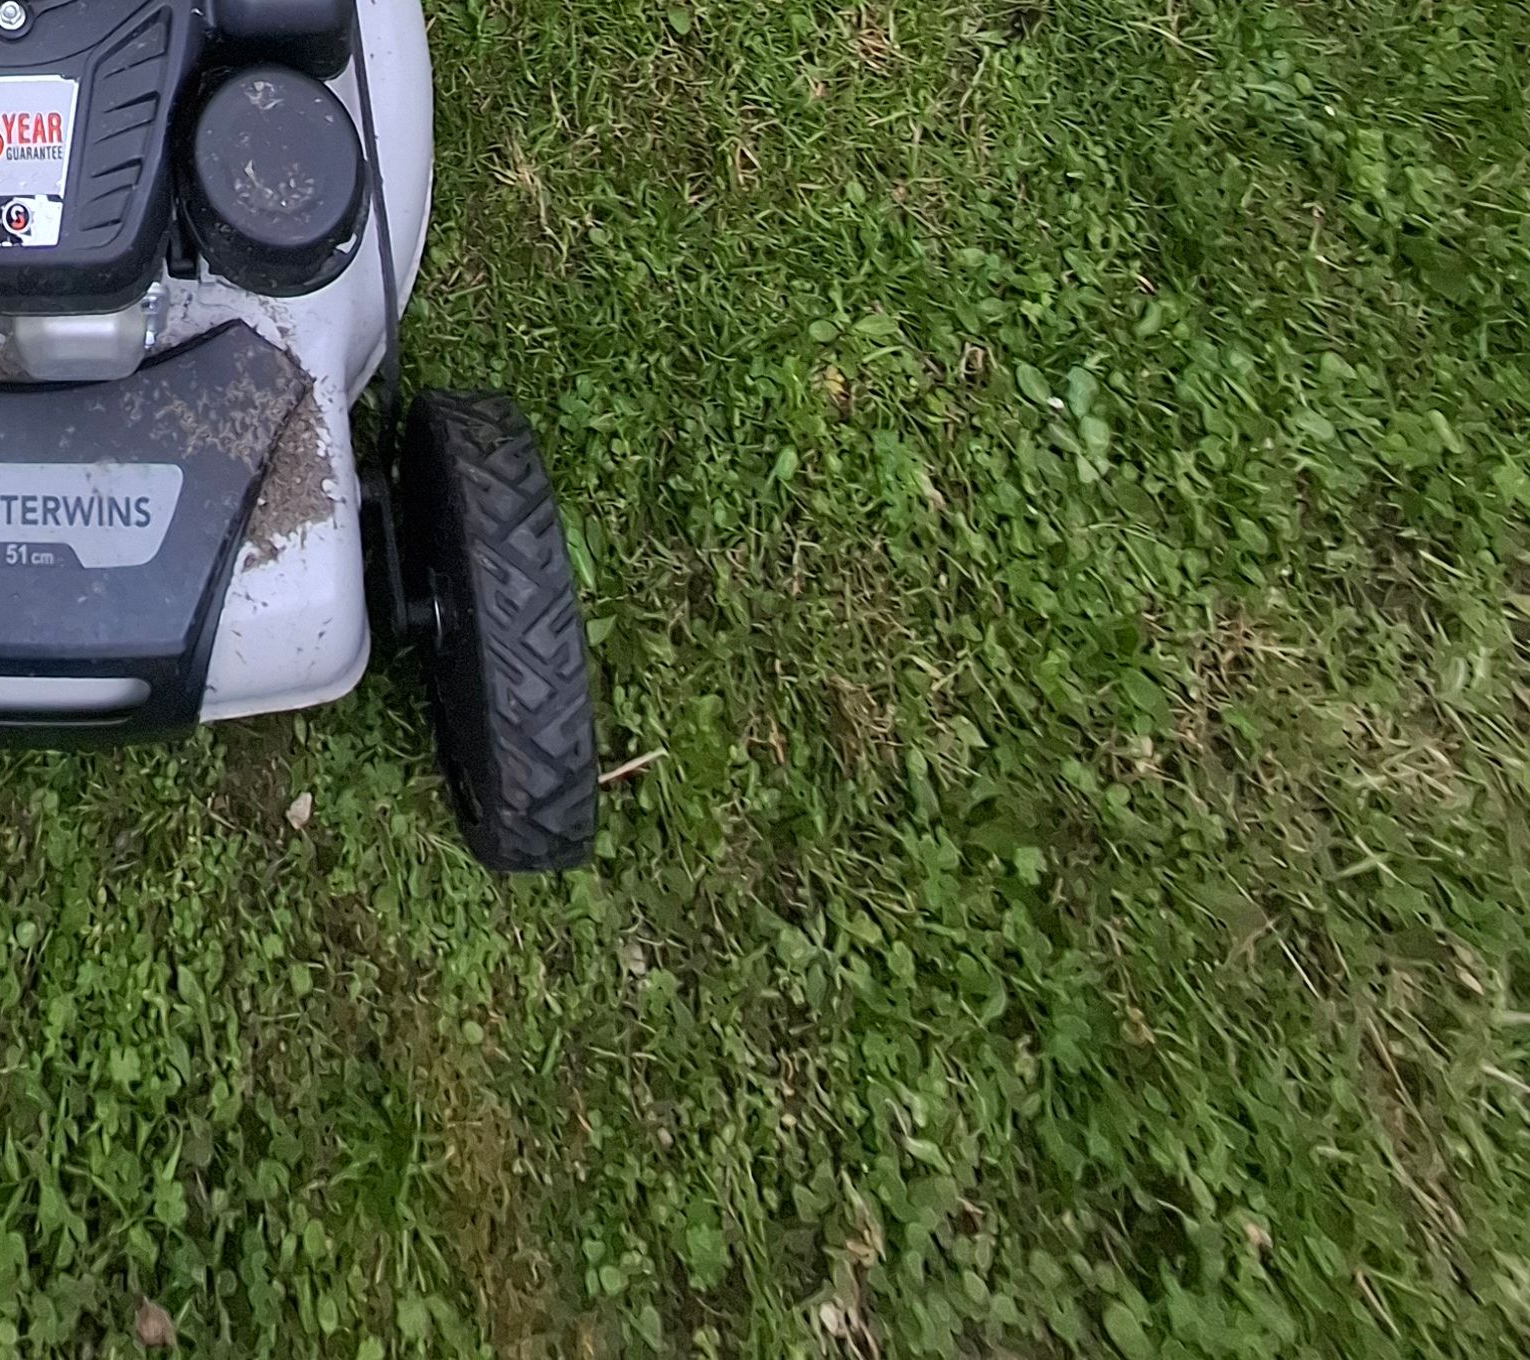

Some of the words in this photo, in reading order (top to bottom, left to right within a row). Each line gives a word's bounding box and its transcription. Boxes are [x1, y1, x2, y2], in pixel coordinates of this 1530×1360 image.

[2, 113, 62, 144] YEAR
[6, 145, 63, 161] GUARANTEE
[6, 543, 27, 565] 51
[31, 552, 54, 565] cm
